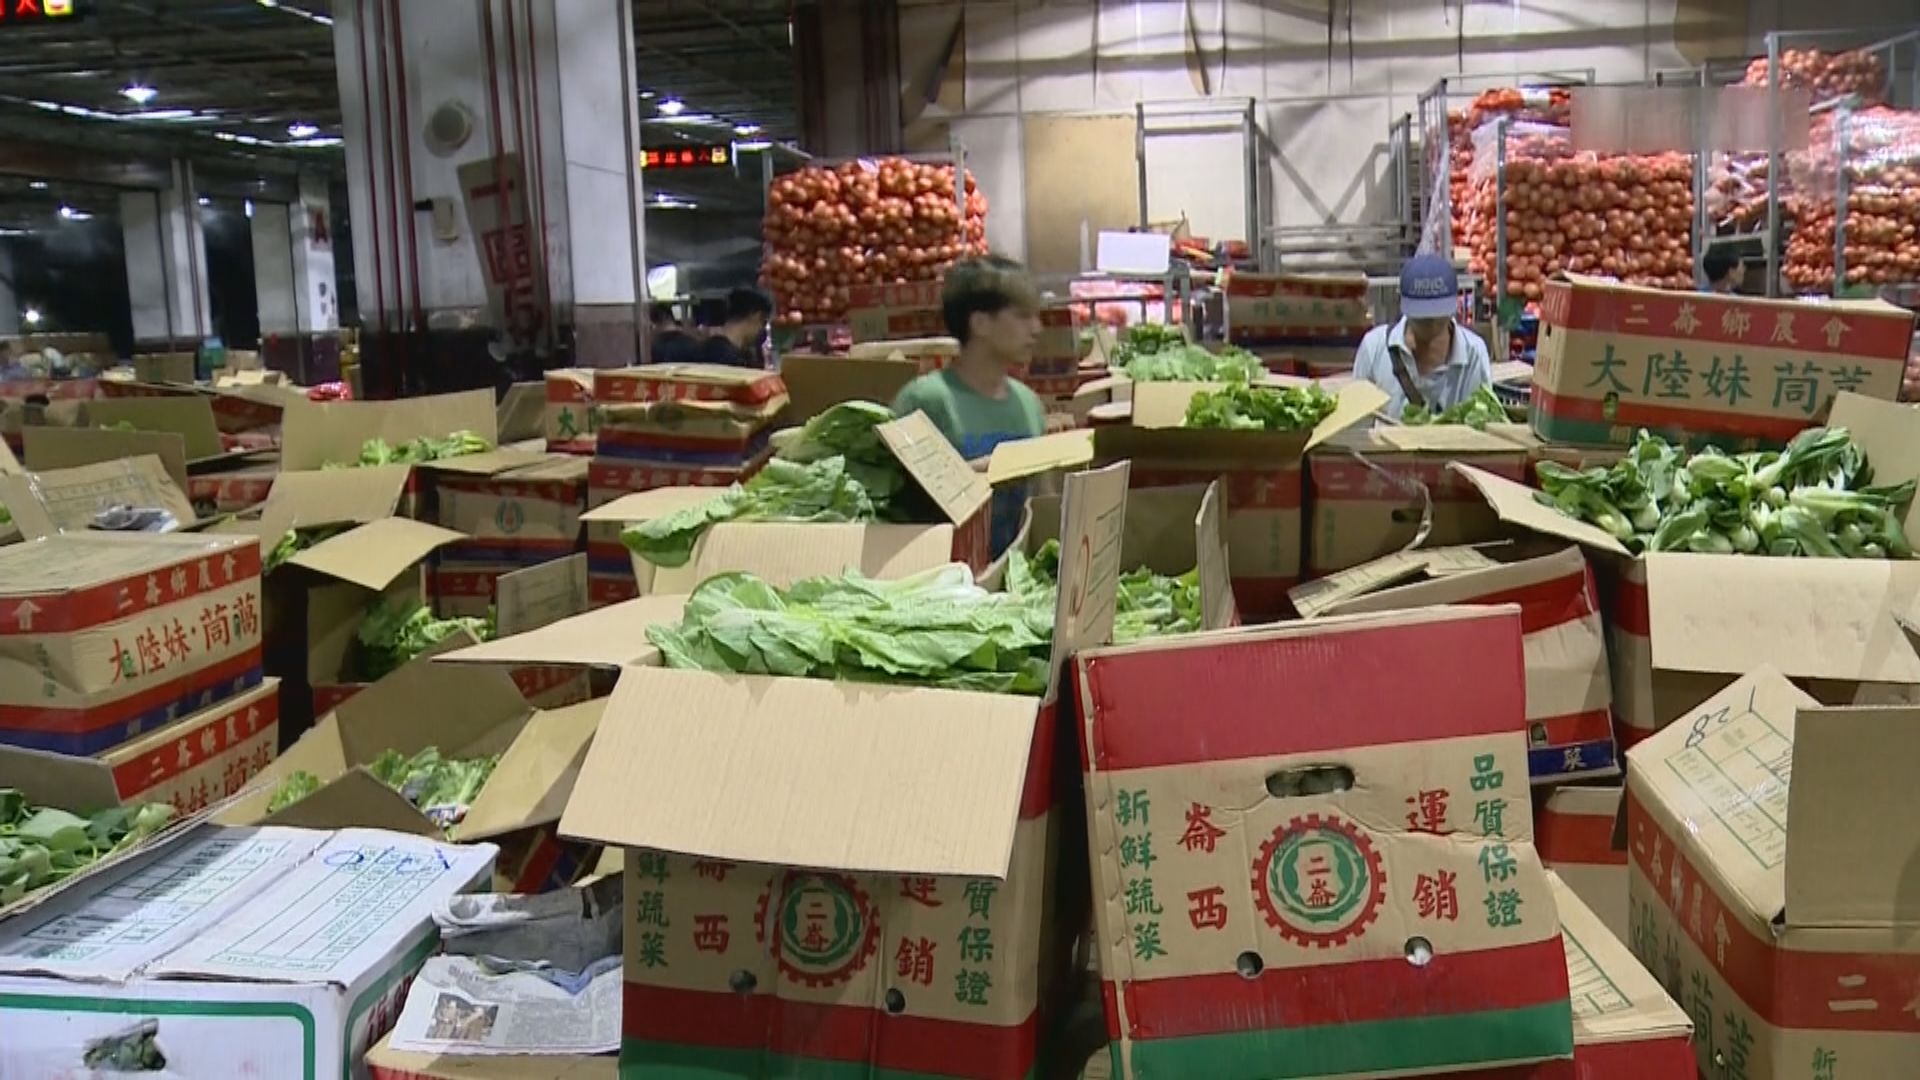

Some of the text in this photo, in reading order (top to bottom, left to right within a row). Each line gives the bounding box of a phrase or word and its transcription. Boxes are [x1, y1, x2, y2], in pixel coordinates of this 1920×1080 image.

[1625, 301, 1852, 347] 二崙鄉農會
[1115, 789, 1168, 962] 新鮮蔬菜
[1470, 753, 1524, 928] 品質保證
